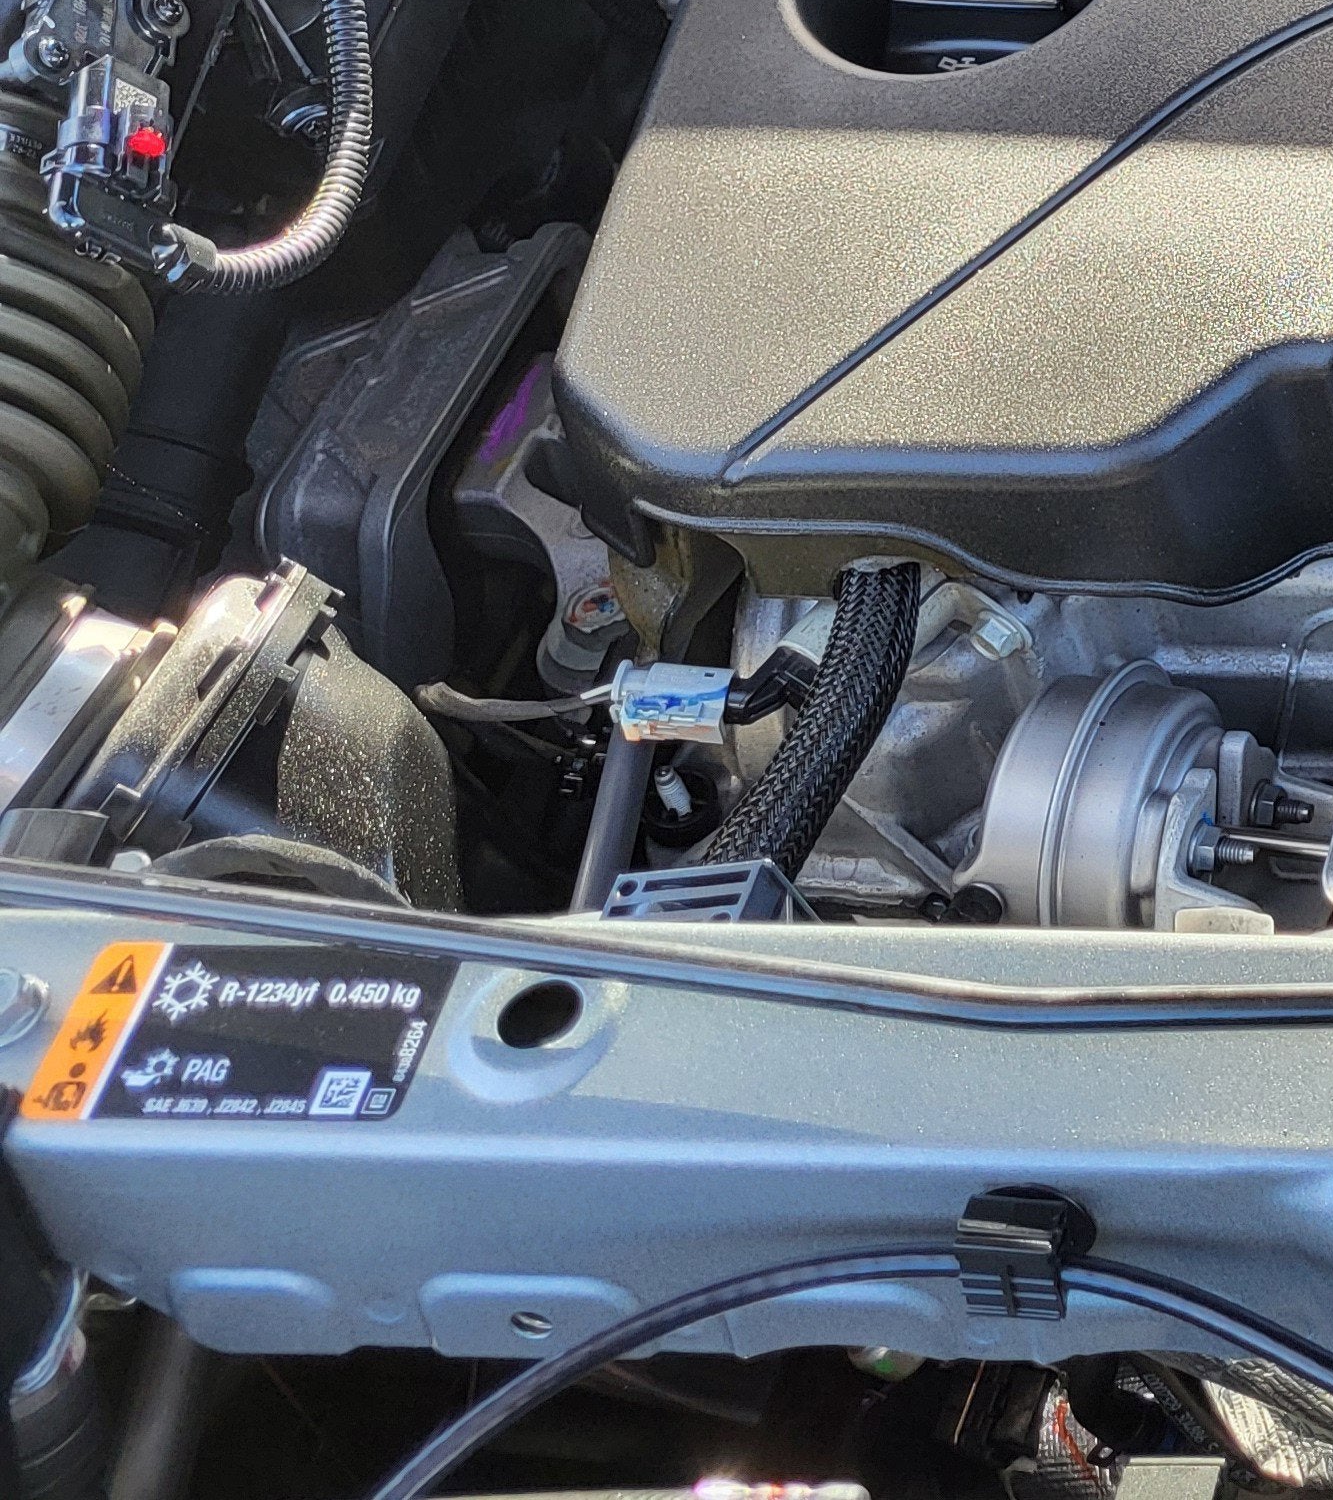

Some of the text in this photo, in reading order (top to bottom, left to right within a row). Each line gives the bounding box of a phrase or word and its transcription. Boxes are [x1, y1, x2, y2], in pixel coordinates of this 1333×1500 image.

[218, 979, 422, 1008] R-1234yf 0.450 kg
[182, 1056, 231, 1085] PAG
[142, 1098, 171, 1113] SAE
